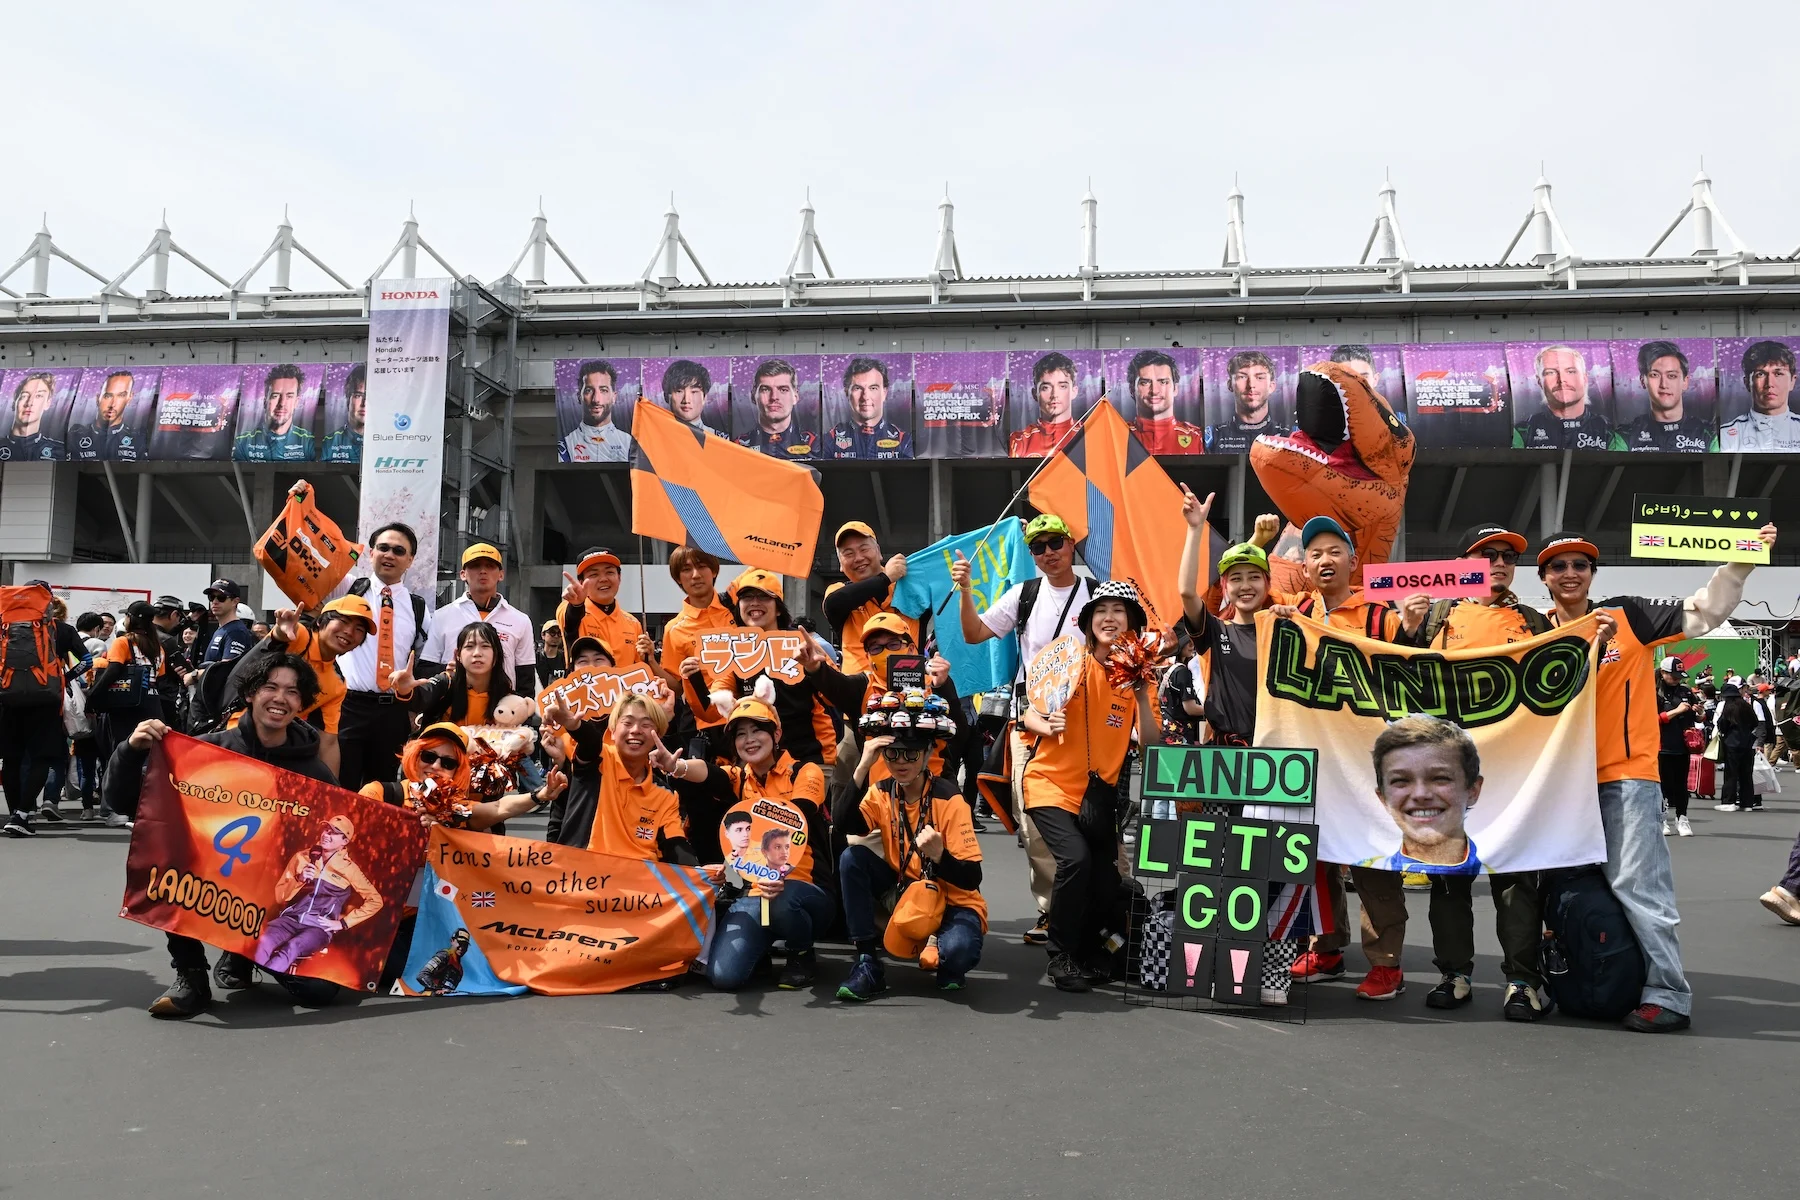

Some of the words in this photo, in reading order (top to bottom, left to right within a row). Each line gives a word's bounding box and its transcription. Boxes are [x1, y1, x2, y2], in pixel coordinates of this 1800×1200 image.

[381, 291, 439, 300] HONDA
[1415, 379, 1467, 387] FORMULA
[923, 391, 969, 400] FORMULA
[970, 392, 977, 400] 1
[923, 399, 945, 407] MSC
[946, 399, 984, 407] CRUISES
[1416, 392, 1470, 400] JAPANESE
[1417, 399, 1455, 407] GRAND
[1456, 398, 1481, 406] PRIX
[161, 406, 181, 414] MSC
[182, 407, 217, 415] CRUISES
[162, 400, 207, 409] FORMULA
[923, 406, 971, 414] JAPANESE
[159, 418, 191, 426] GRAND
[192, 419, 213, 427] PRIX
[160, 412, 207, 421] JAPANESE
[958, 412, 981, 420] PRIX
[373, 433, 394, 441] Blue
[395, 433, 432, 442] Energy
[1576, 433, 1607, 450] Stake
[1675, 434, 1706, 449] Stake
[744, 535, 802, 550] McLaren
[1668, 536, 1731, 551] LANDO
[1396, 573, 1457, 588] OSCAR
[701, 632, 759, 643] マクラーレン
[700, 637, 801, 674] ランド
[1031, 651, 1054, 675] Let's
[1053, 636, 1074, 655] Go!!
[779, 657, 800, 679] 4
[1029, 656, 1061, 689] PAPAYA
[1266, 618, 1593, 729] LANDO
[1146, 748, 1312, 797] LANDO
[168, 772, 233, 804] Lando
[236, 789, 312, 818] Norris
[759, 801, 773, 811] It's
[1138, 819, 1312, 875] LET'S
[440, 842, 491, 868] Fans
[507, 846, 554, 868] like
[734, 857, 779, 881] LANDO
[502, 880, 533, 895] no
[545, 870, 612, 895] other
[146, 865, 267, 941] LANDOOO!
[585, 892, 664, 914] SUZUKA
[1182, 883, 1262, 932] GO
[478, 921, 640, 951] McLaren
[507, 943, 559, 953] FORMULA
[579, 952, 613, 965] TEAM
